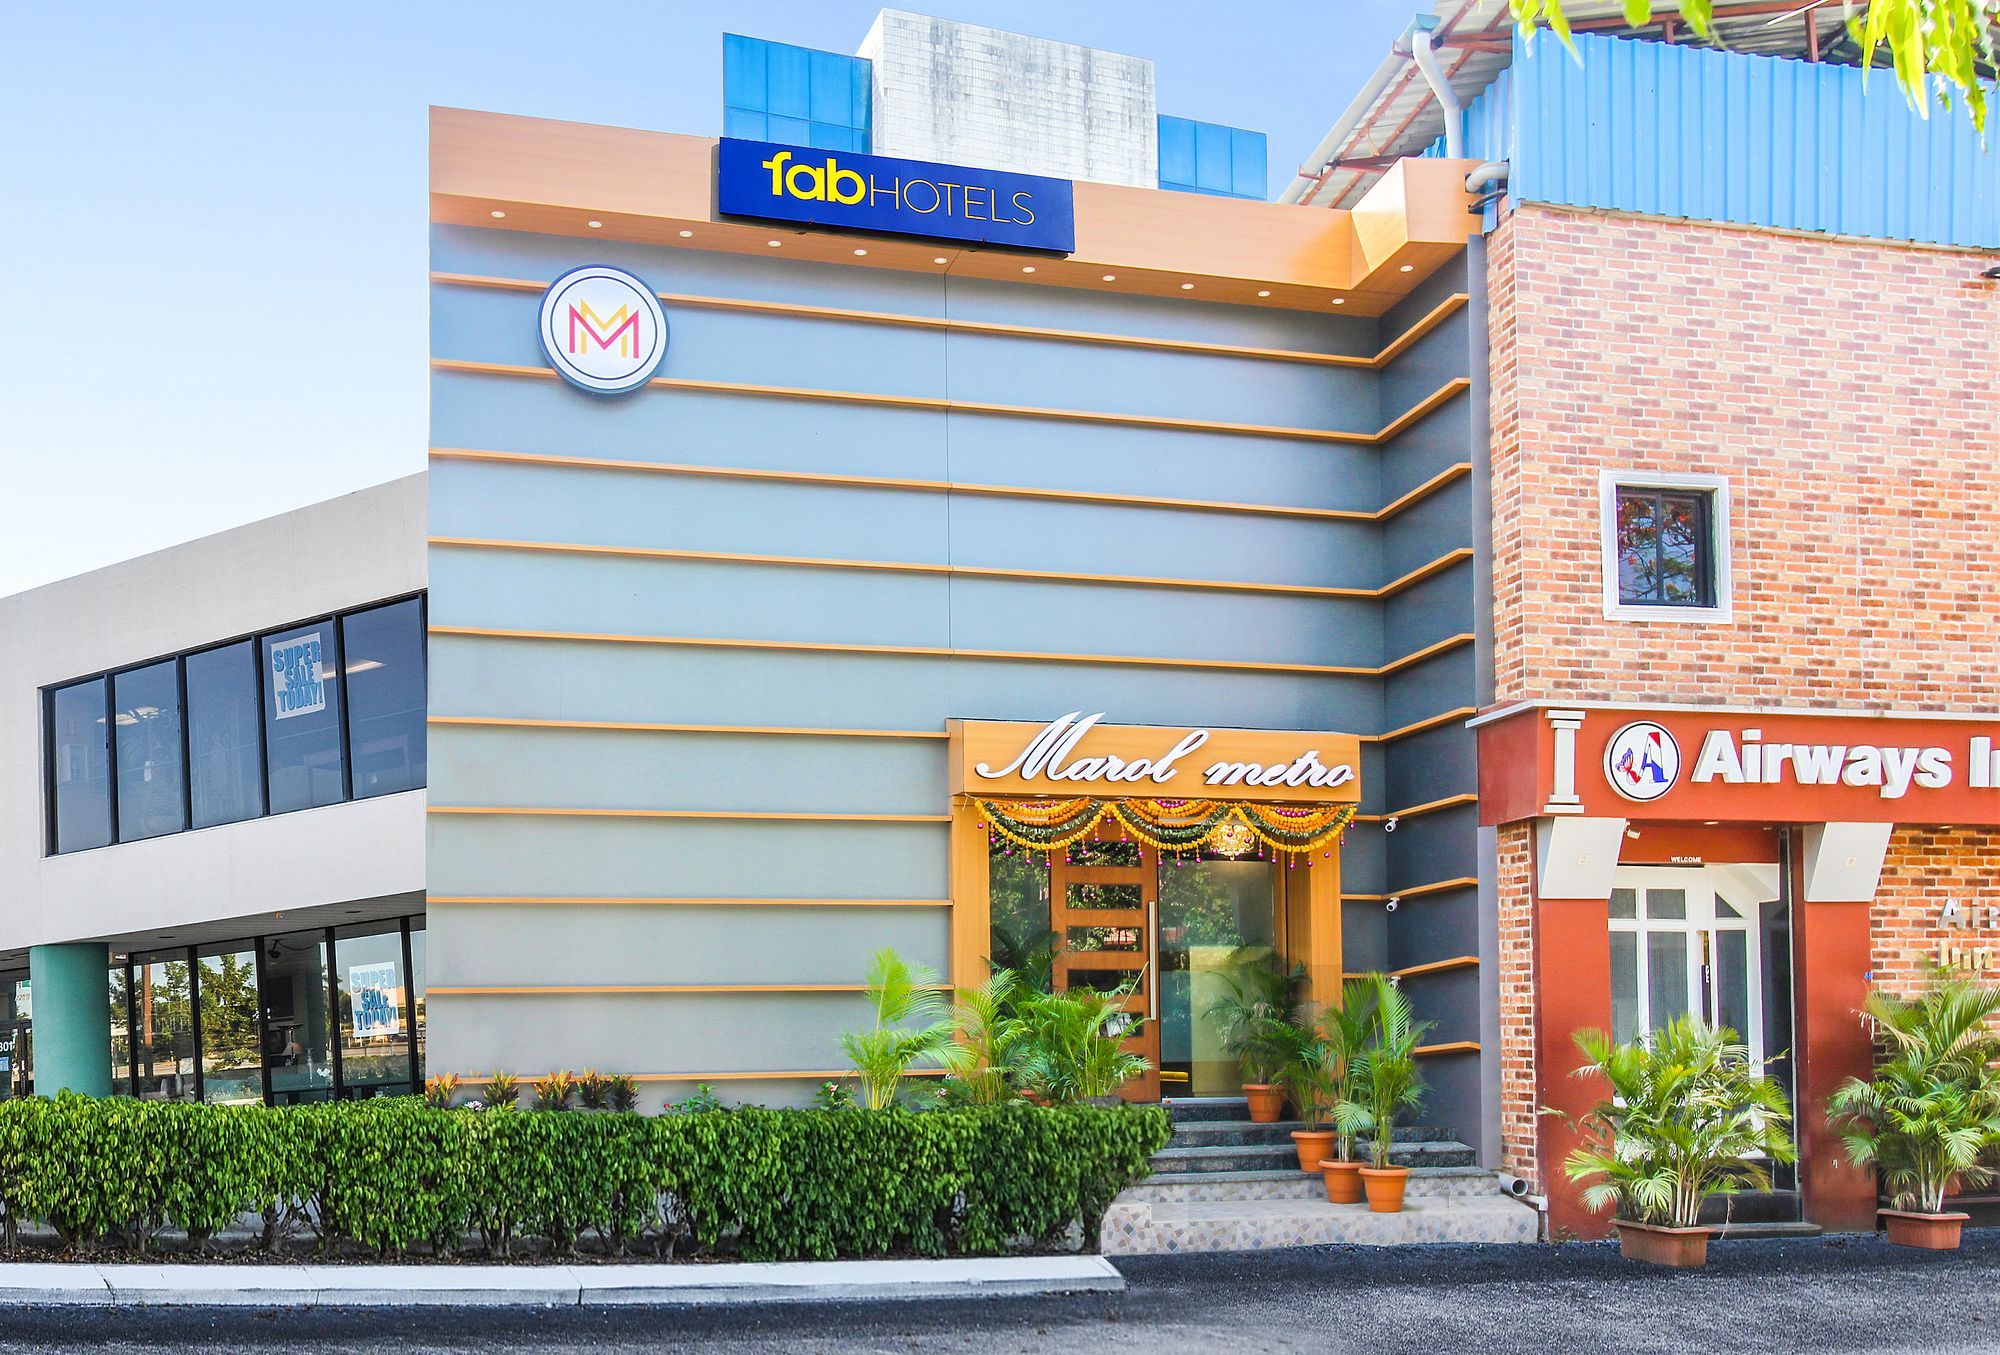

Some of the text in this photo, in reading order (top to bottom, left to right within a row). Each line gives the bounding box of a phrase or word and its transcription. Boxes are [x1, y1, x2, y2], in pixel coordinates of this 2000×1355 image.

[273, 640, 321, 672] SUPER
[284, 663, 315, 690] SALE
[277, 681, 324, 712] TODAY!
[975, 711, 1355, 787] Marol metro
[1690, 728, 1953, 799] Airways
[1670, 855, 1702, 864] WELCOME
[350, 968, 396, 993] SUPER
[361, 988, 390, 1011] SALE
[353, 1006, 397, 1030] TODAY!
